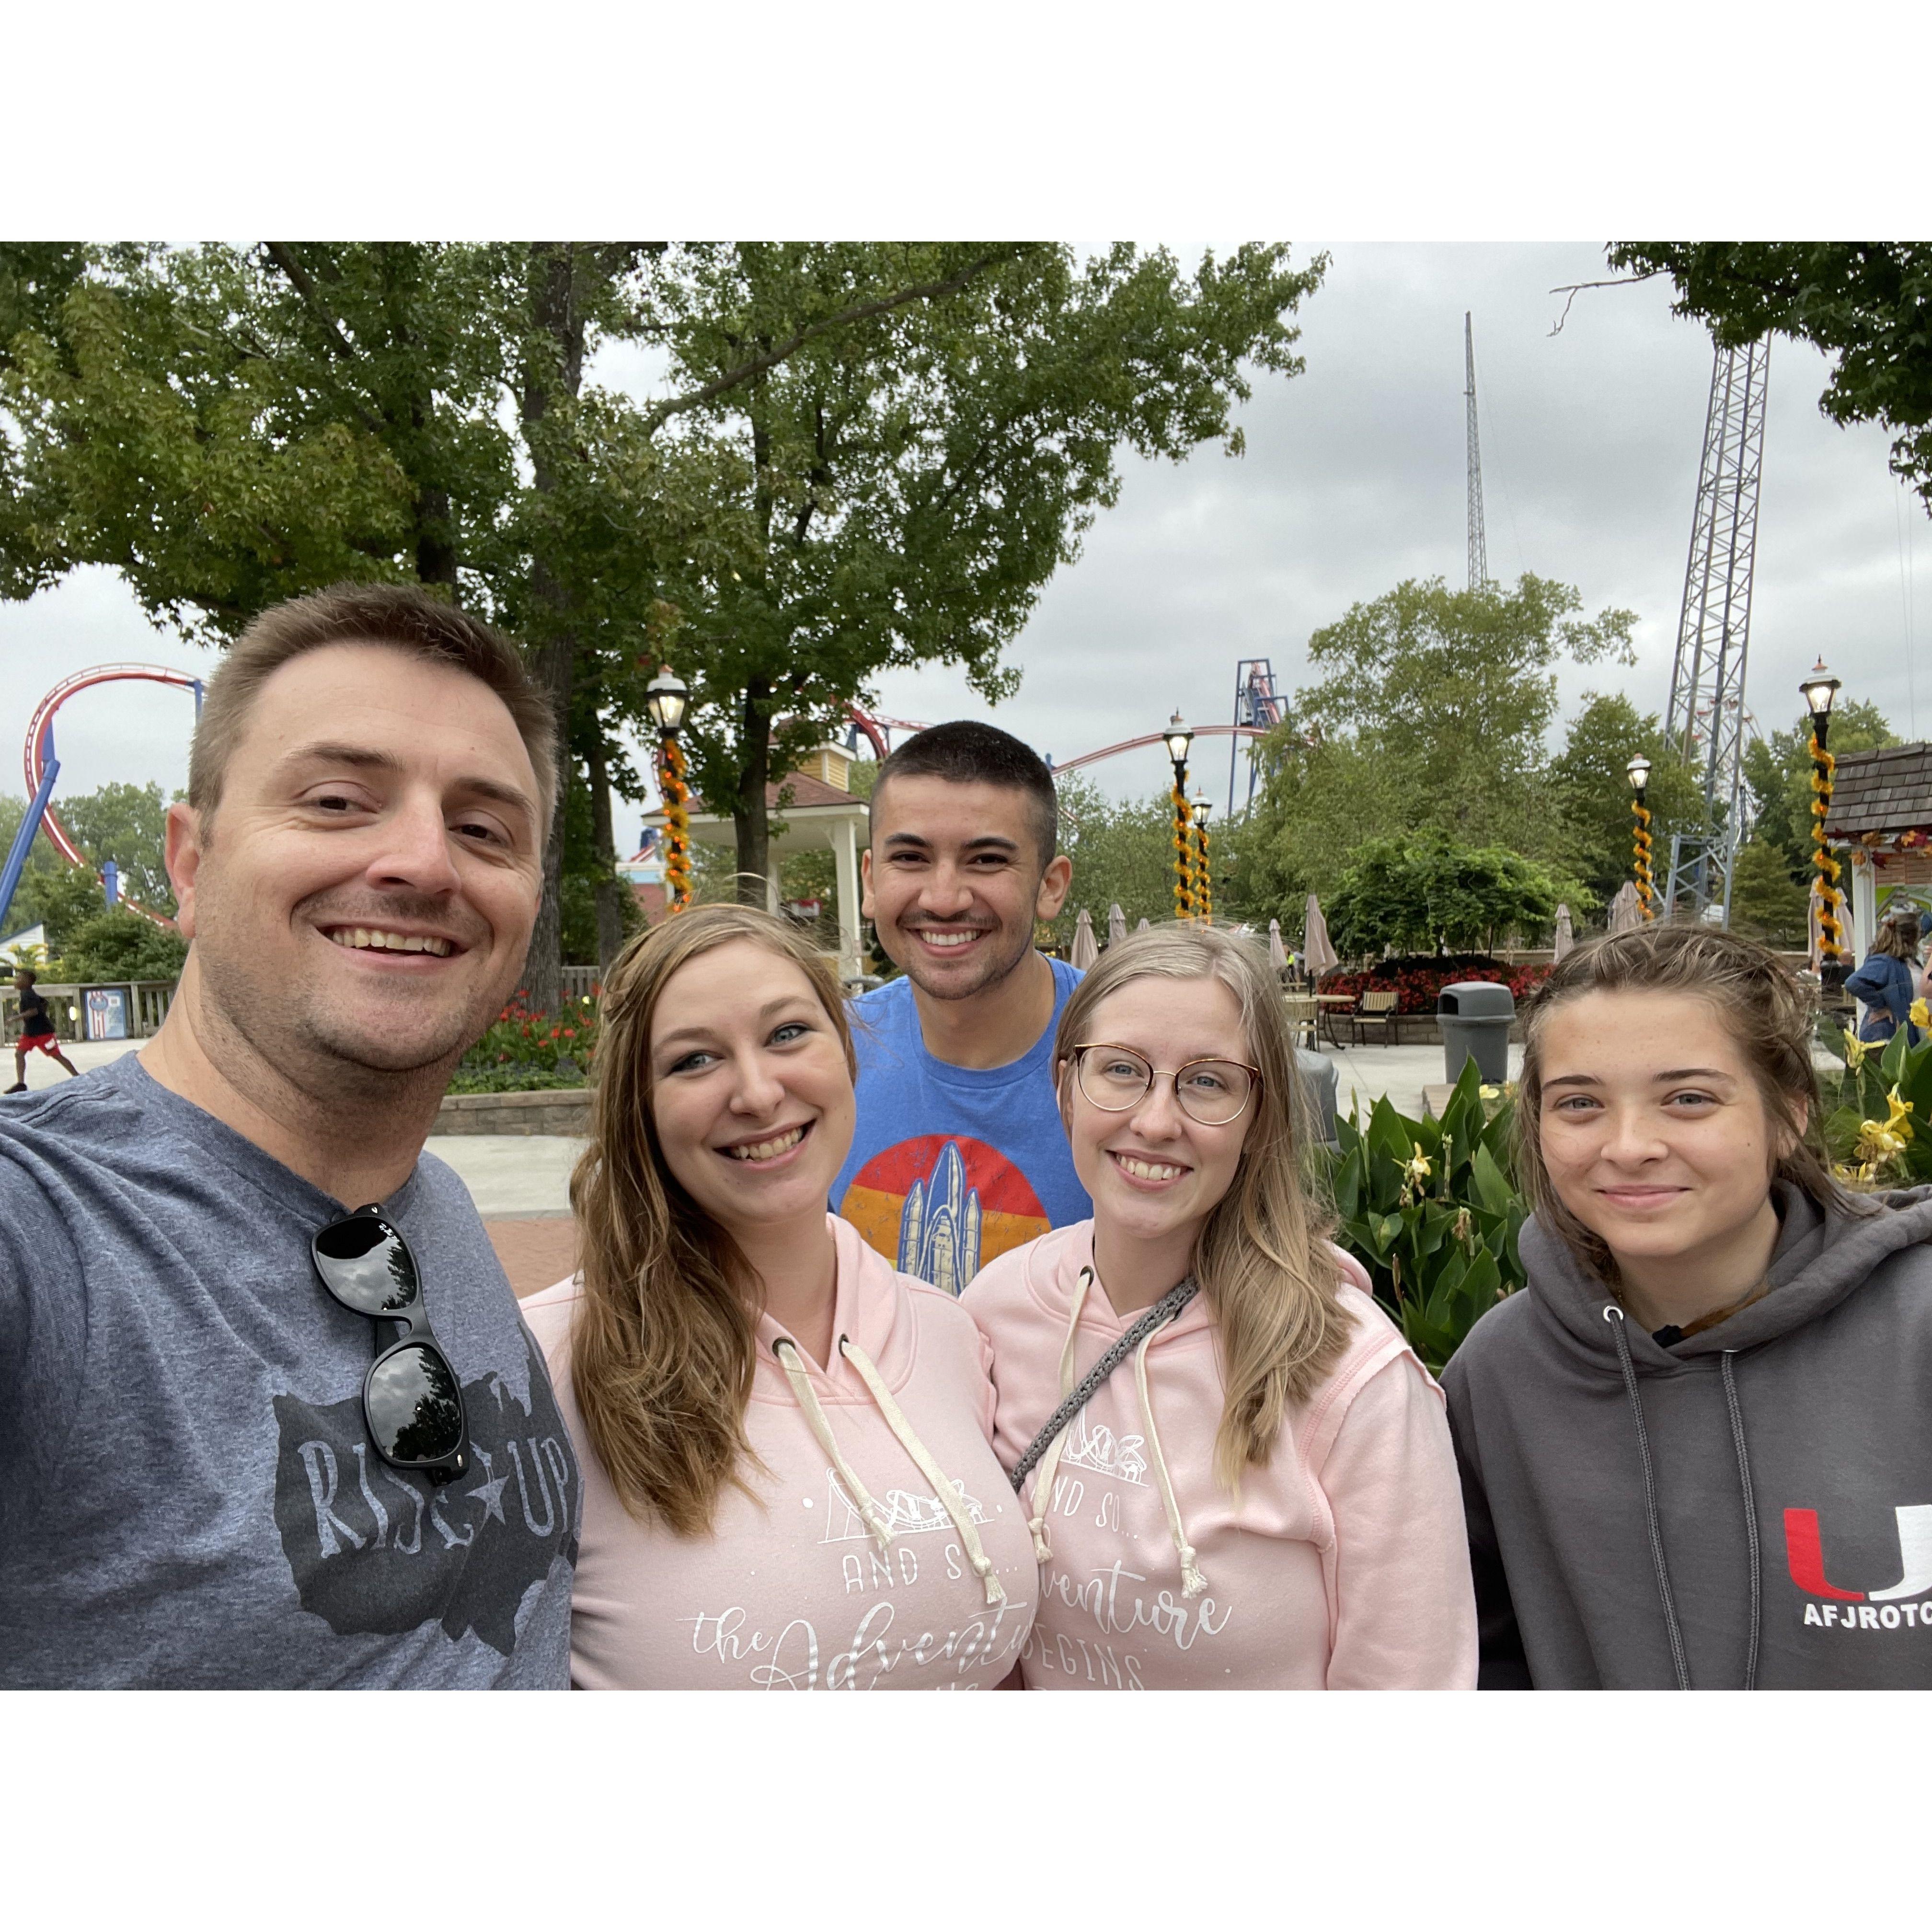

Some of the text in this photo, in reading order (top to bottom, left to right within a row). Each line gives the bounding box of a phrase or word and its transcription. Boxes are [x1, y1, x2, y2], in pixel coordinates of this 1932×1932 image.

[507, 1437, 569, 1537] UP
[1030, 1475, 1084, 1517] ND
[842, 1543, 1018, 1594] AND S...
[1037, 1533, 1233, 1650] venture
[675, 1606, 773, 1664] the
[1803, 1600, 1932, 1630] AFJROTC
